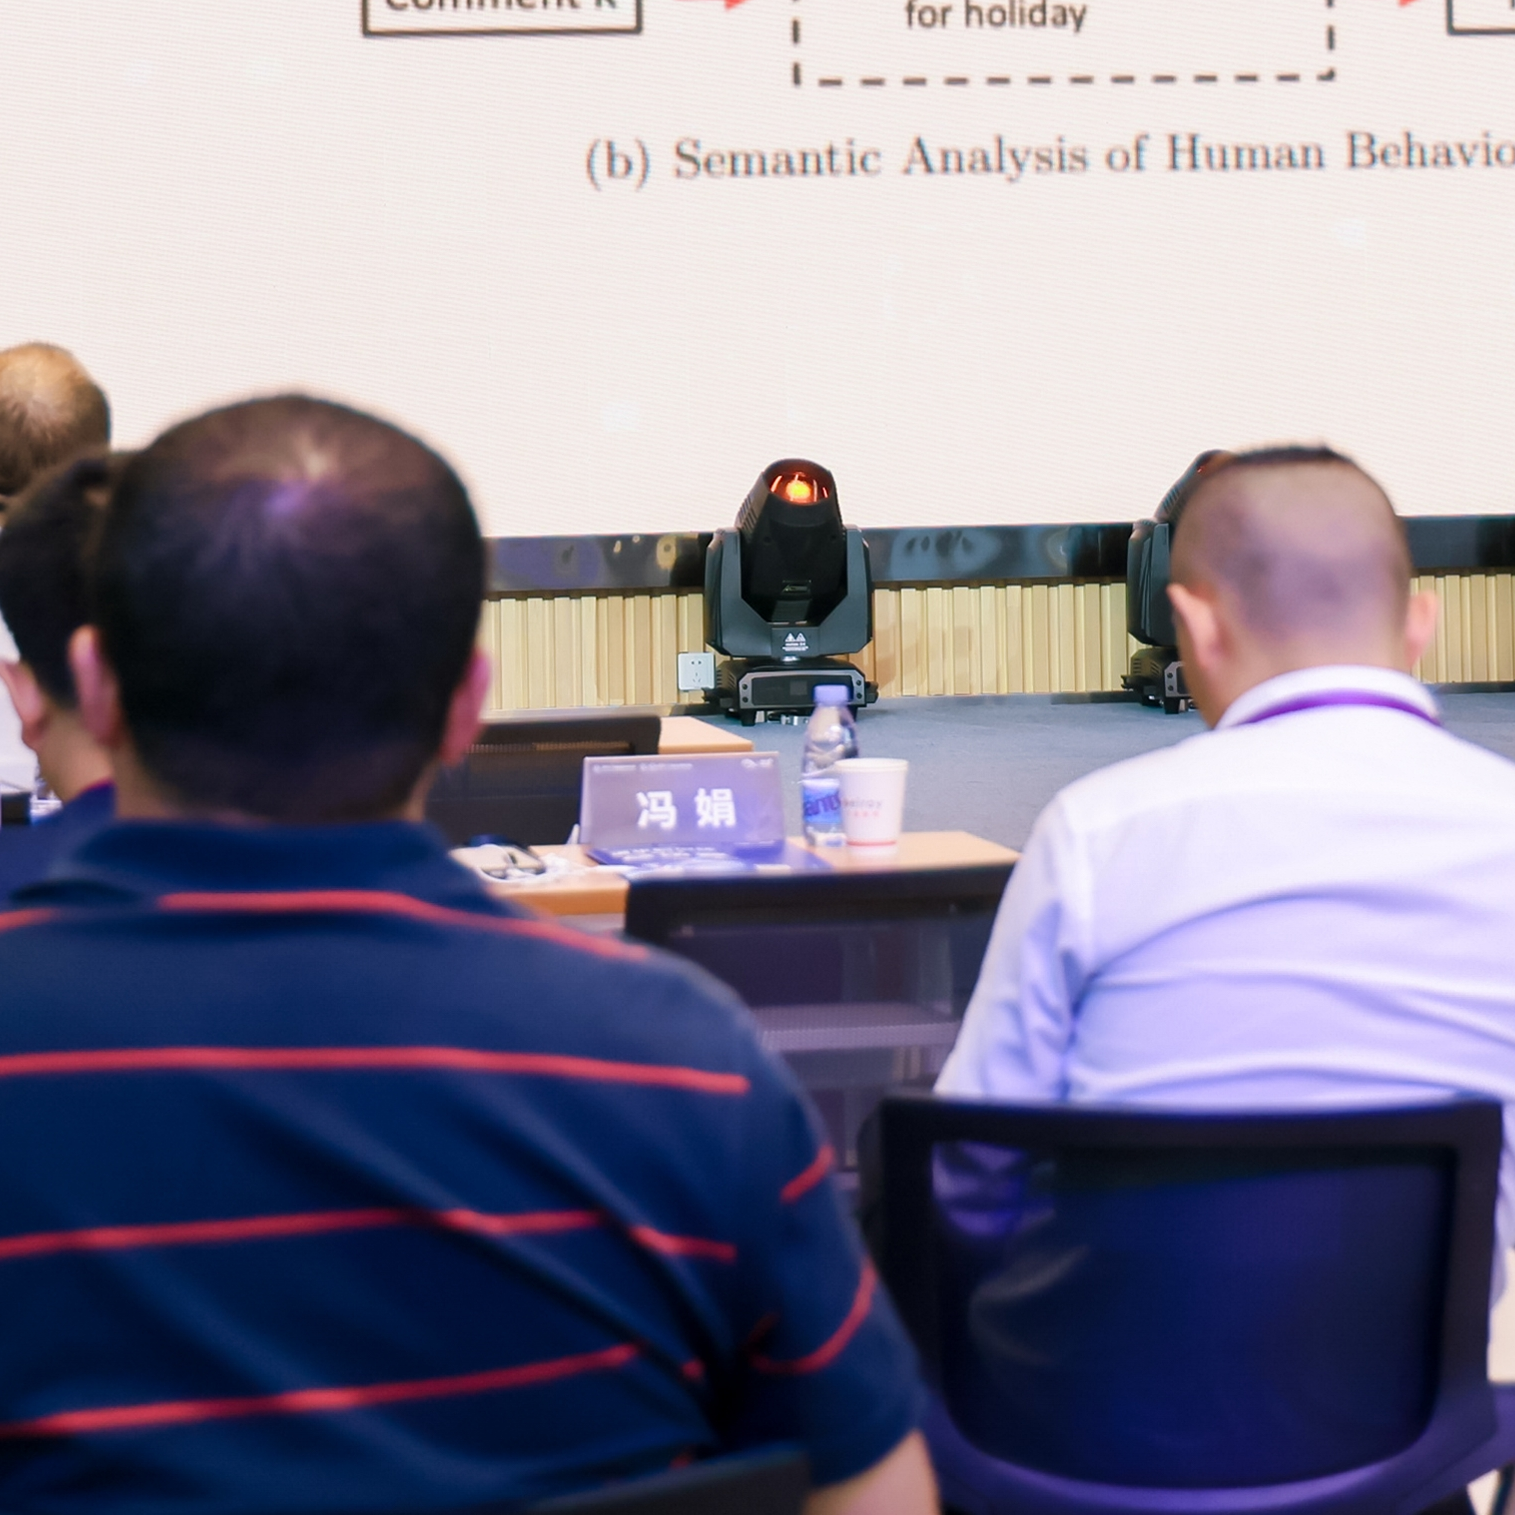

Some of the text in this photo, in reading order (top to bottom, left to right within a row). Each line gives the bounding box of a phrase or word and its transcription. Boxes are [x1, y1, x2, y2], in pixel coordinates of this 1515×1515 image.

[585, 139, 651, 191] (b)
[674, 137, 882, 180] Semantic
[902, 134, 1090, 184] Analysis
[1104, 133, 1150, 172] of
[1167, 132, 1326, 173] Human
